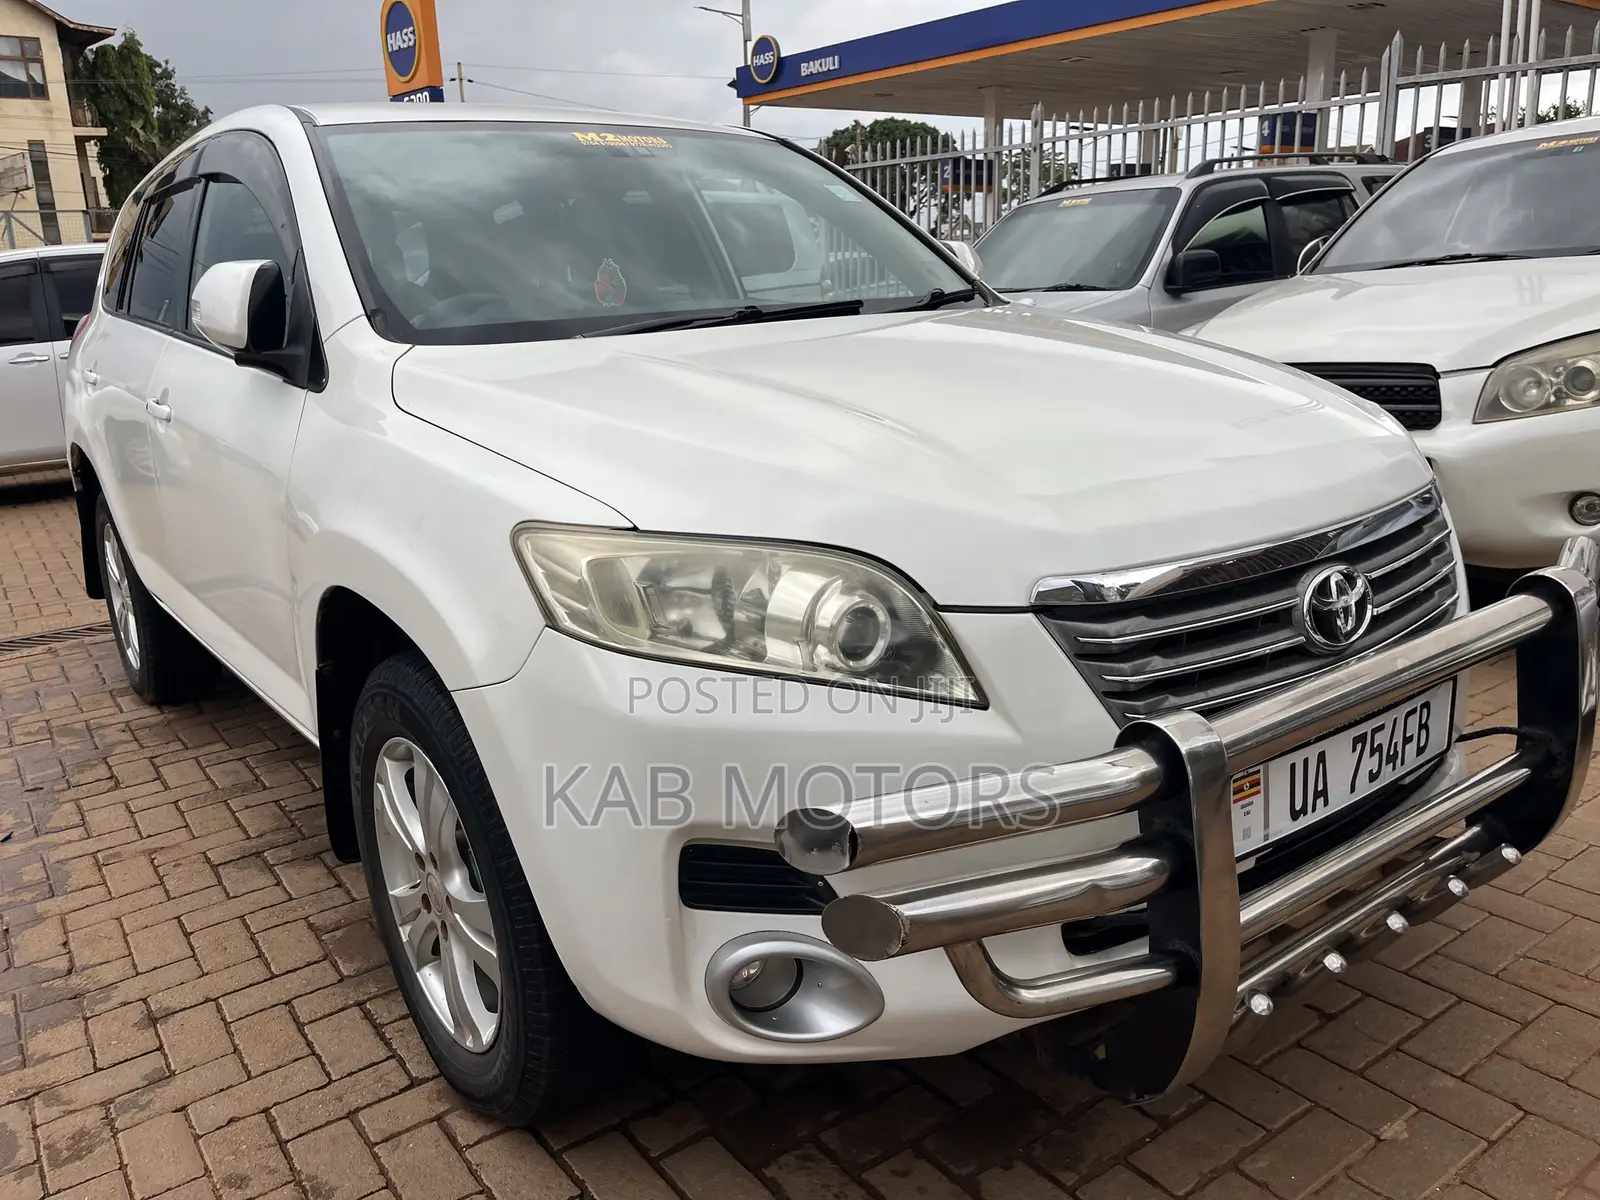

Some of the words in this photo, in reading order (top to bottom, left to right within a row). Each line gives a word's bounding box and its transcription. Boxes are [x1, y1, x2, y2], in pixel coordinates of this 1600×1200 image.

[387, 26, 416, 53] HASS
[753, 52, 774, 66] HASS
[801, 55, 840, 76] BAKULI
[1261, 120, 1270, 136] 4
[943, 165, 951, 178] 2
[1289, 749, 1329, 822] UA
[1350, 700, 1431, 794] 754FB
